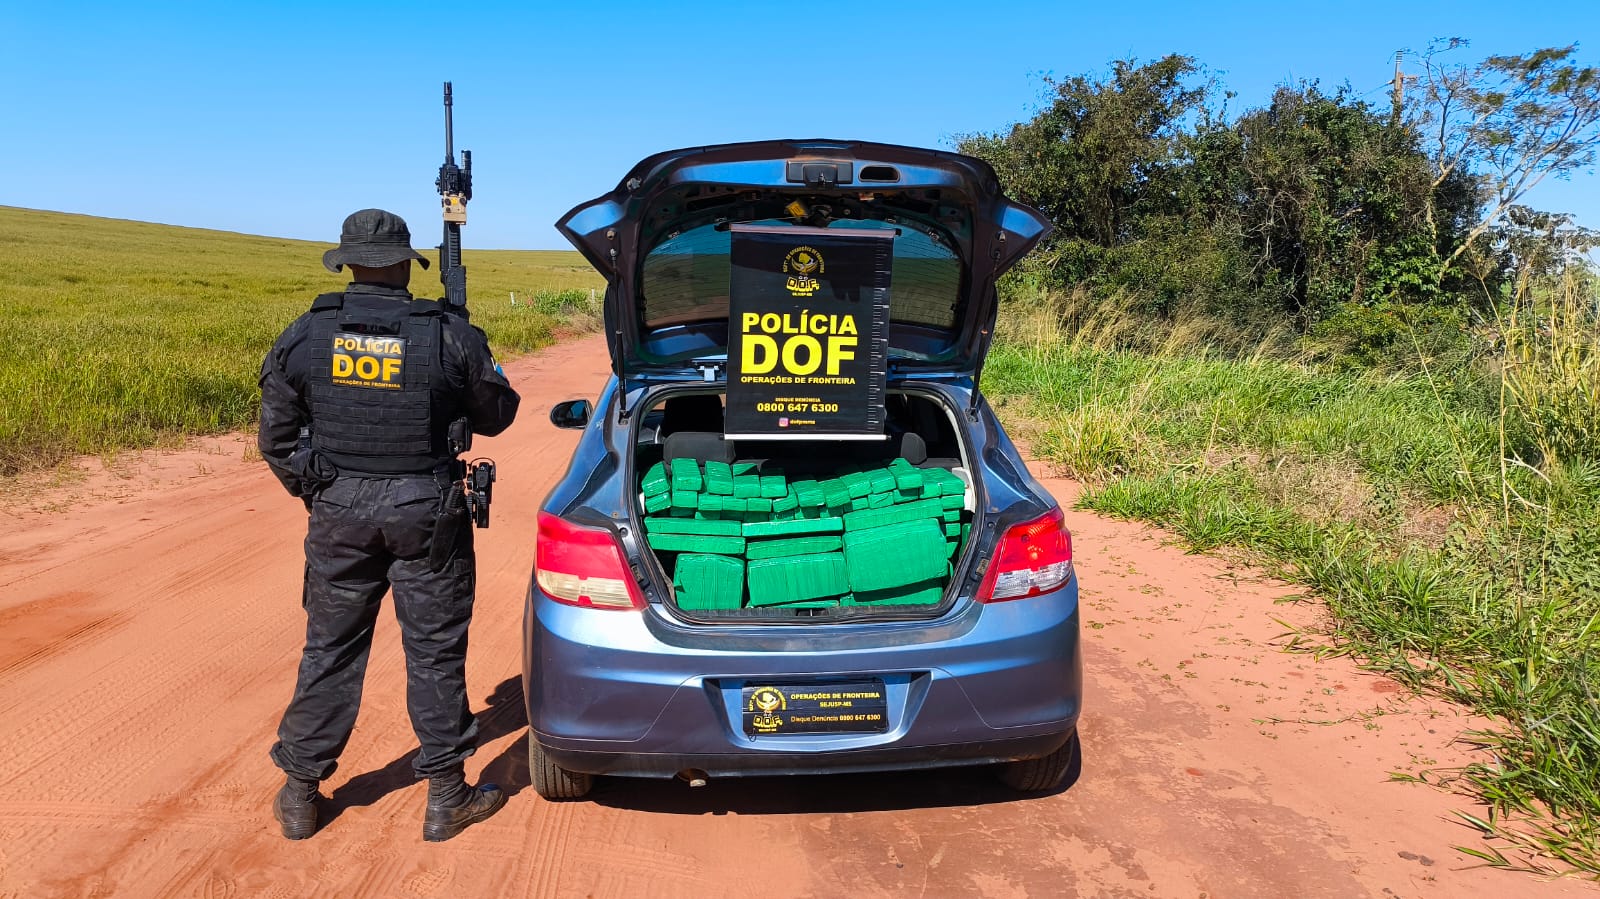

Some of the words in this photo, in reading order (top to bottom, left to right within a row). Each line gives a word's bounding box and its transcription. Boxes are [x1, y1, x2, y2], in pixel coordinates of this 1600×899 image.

[742, 309, 858, 335] POLÍCIA
[741, 334, 858, 376] DOF
[332, 353, 402, 382] DOF
[740, 376, 793, 385] OPERAÇÕES
[808, 377, 856, 385] FRONTEIRA
[757, 403, 785, 412] 0800
[787, 403, 809, 412] 647
[811, 403, 839, 413] 6300
[790, 693, 831, 701] OPERAÇÕES
[790, 715, 811, 723] Disque
